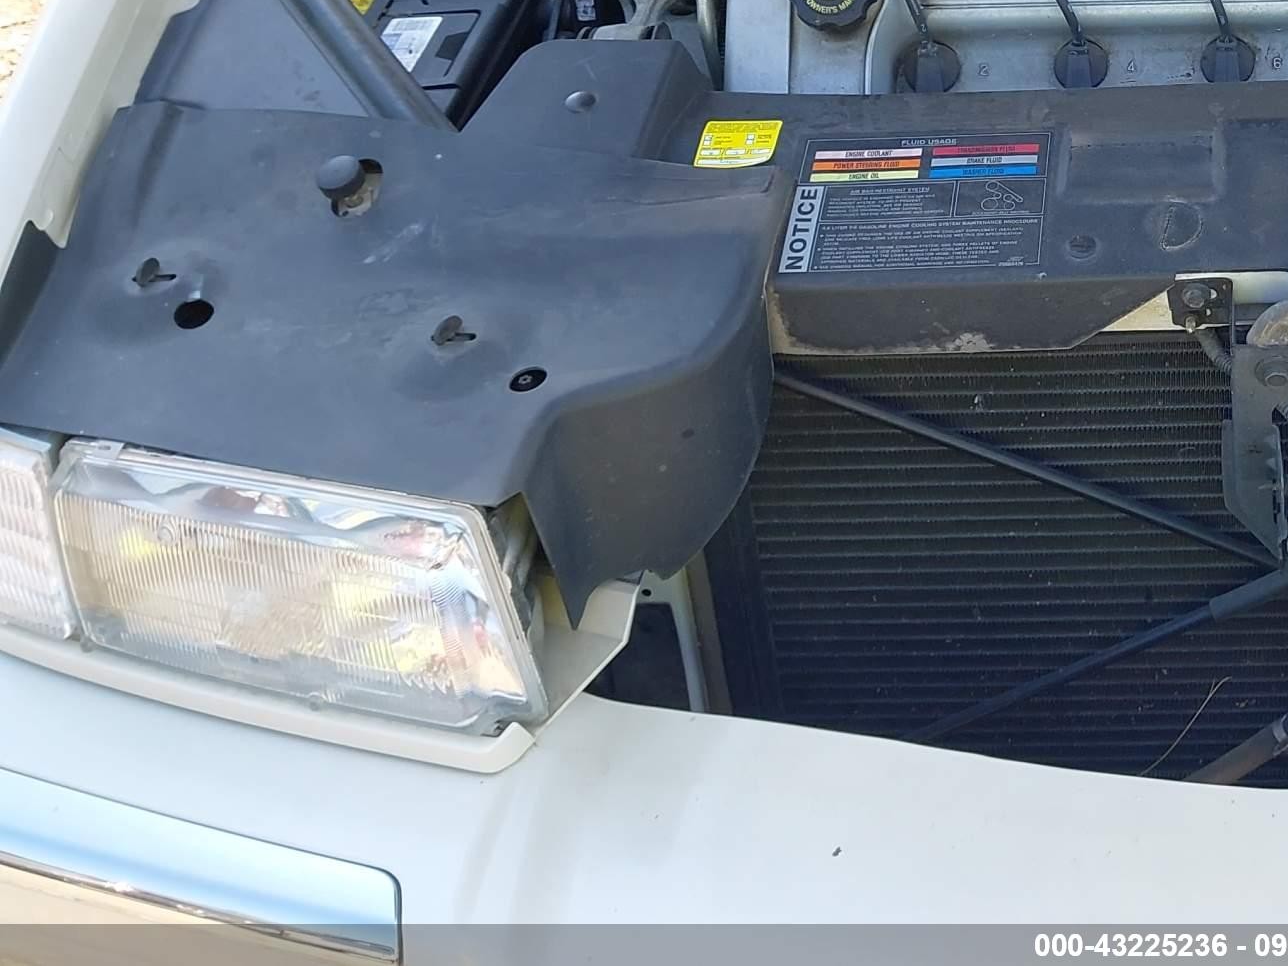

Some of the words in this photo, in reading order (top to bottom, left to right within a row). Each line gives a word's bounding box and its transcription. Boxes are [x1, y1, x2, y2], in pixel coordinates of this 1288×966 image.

[1126, 59, 1137, 74] 4
[1272, 56, 1283, 69] 6
[784, 189, 818, 269] NOTICE
